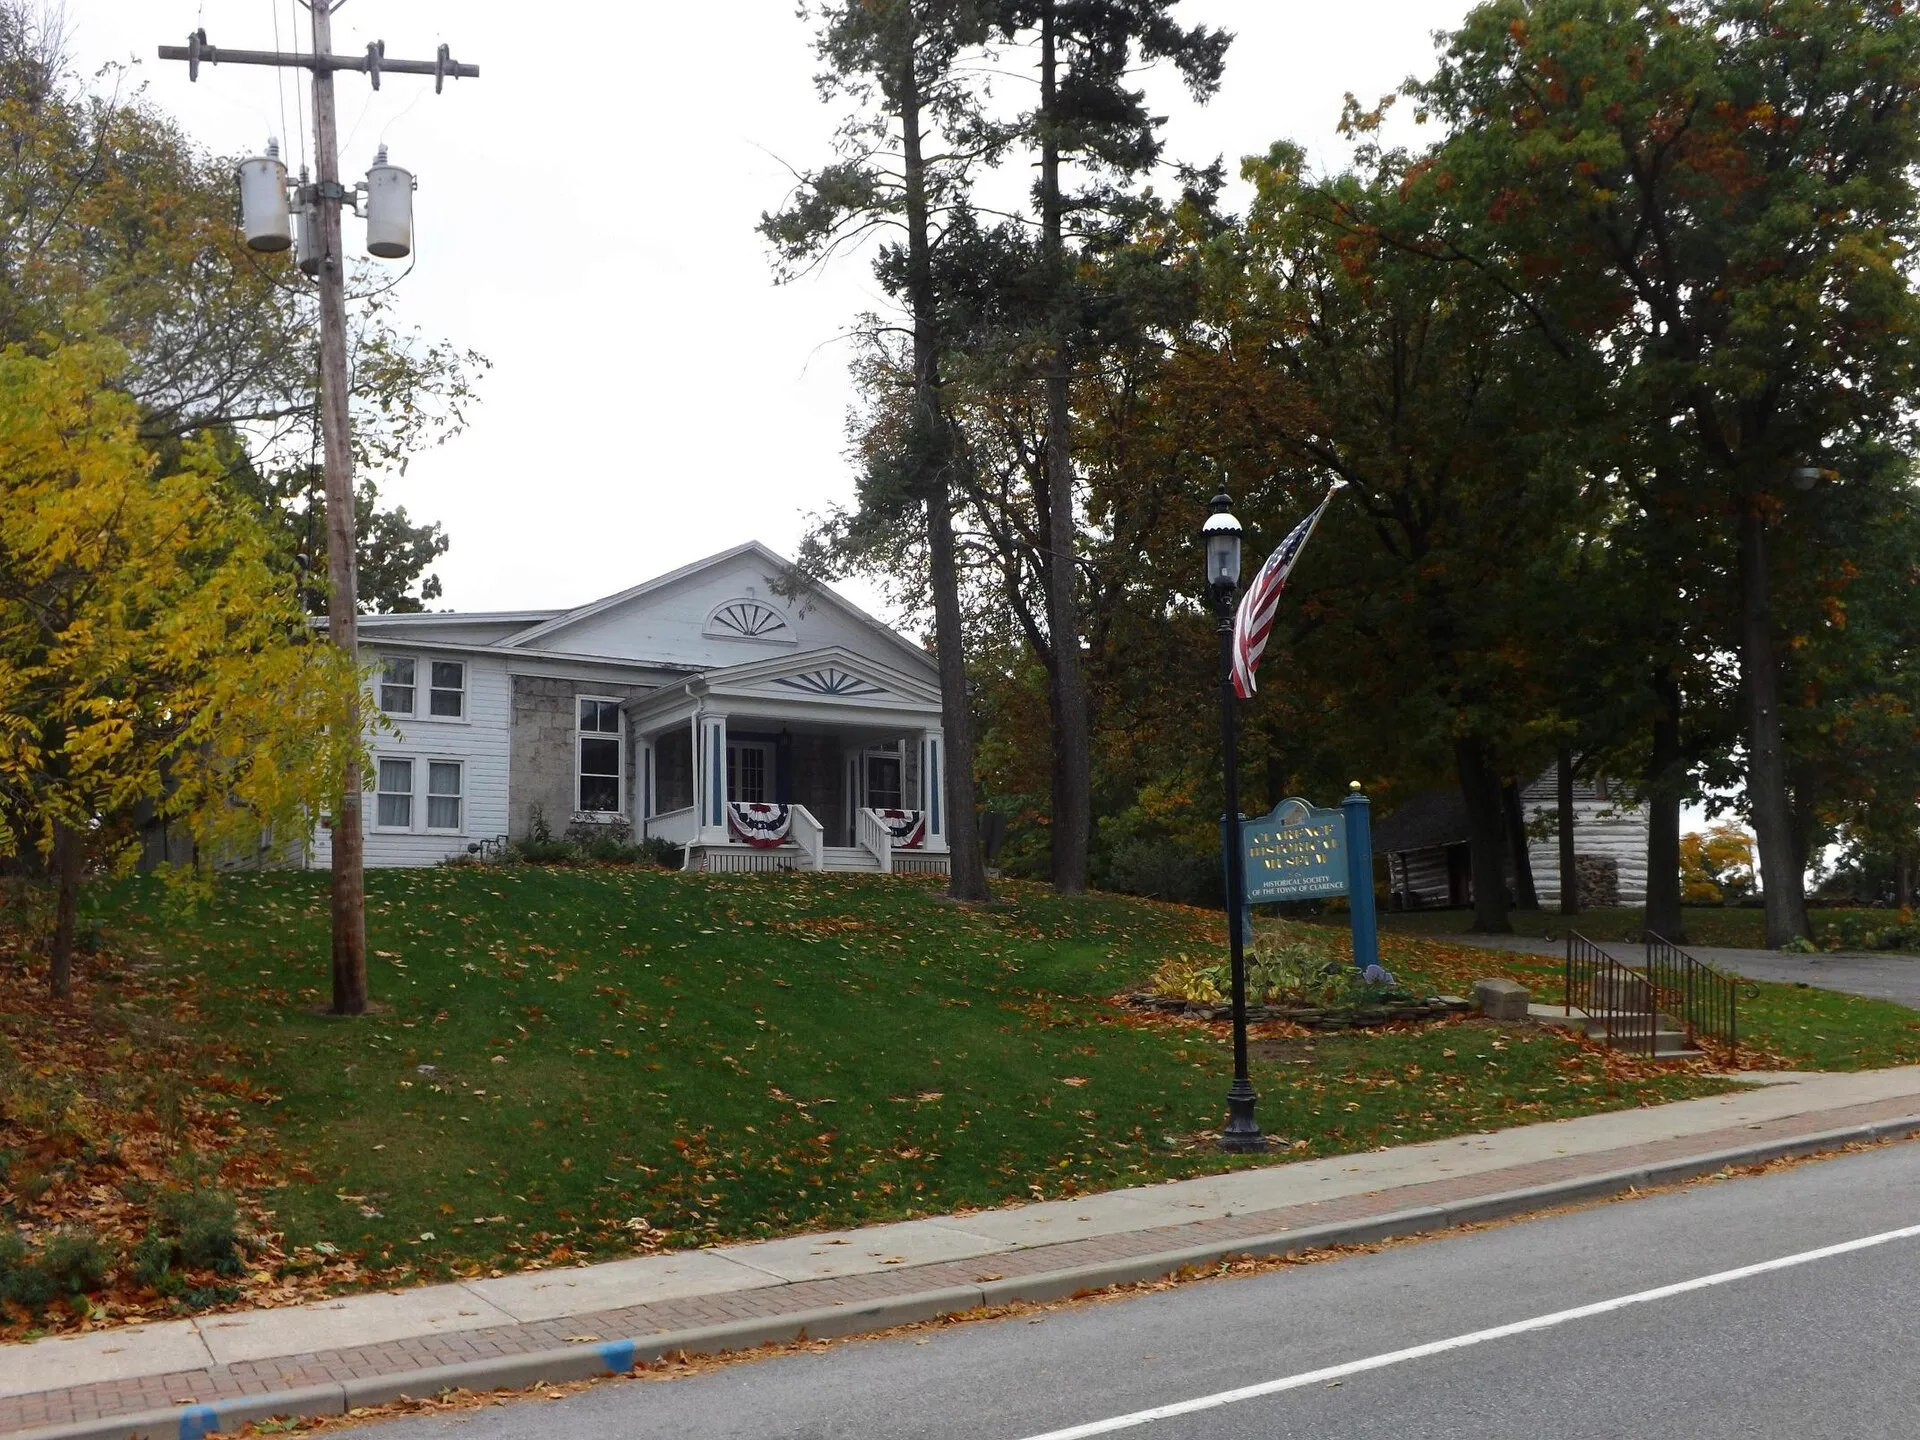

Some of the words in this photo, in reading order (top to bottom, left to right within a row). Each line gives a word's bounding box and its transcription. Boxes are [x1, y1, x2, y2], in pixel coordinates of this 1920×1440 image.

[1252, 888, 1261, 896] OF
[1263, 887, 1275, 895] THE
[1276, 885, 1297, 894] TOWN
[1299, 884, 1308, 892] OF
[1309, 880, 1345, 891] CLARENCE
[1263, 878, 1300, 888] HISTORICAL
[1302, 875, 1330, 885] SOCIETY
